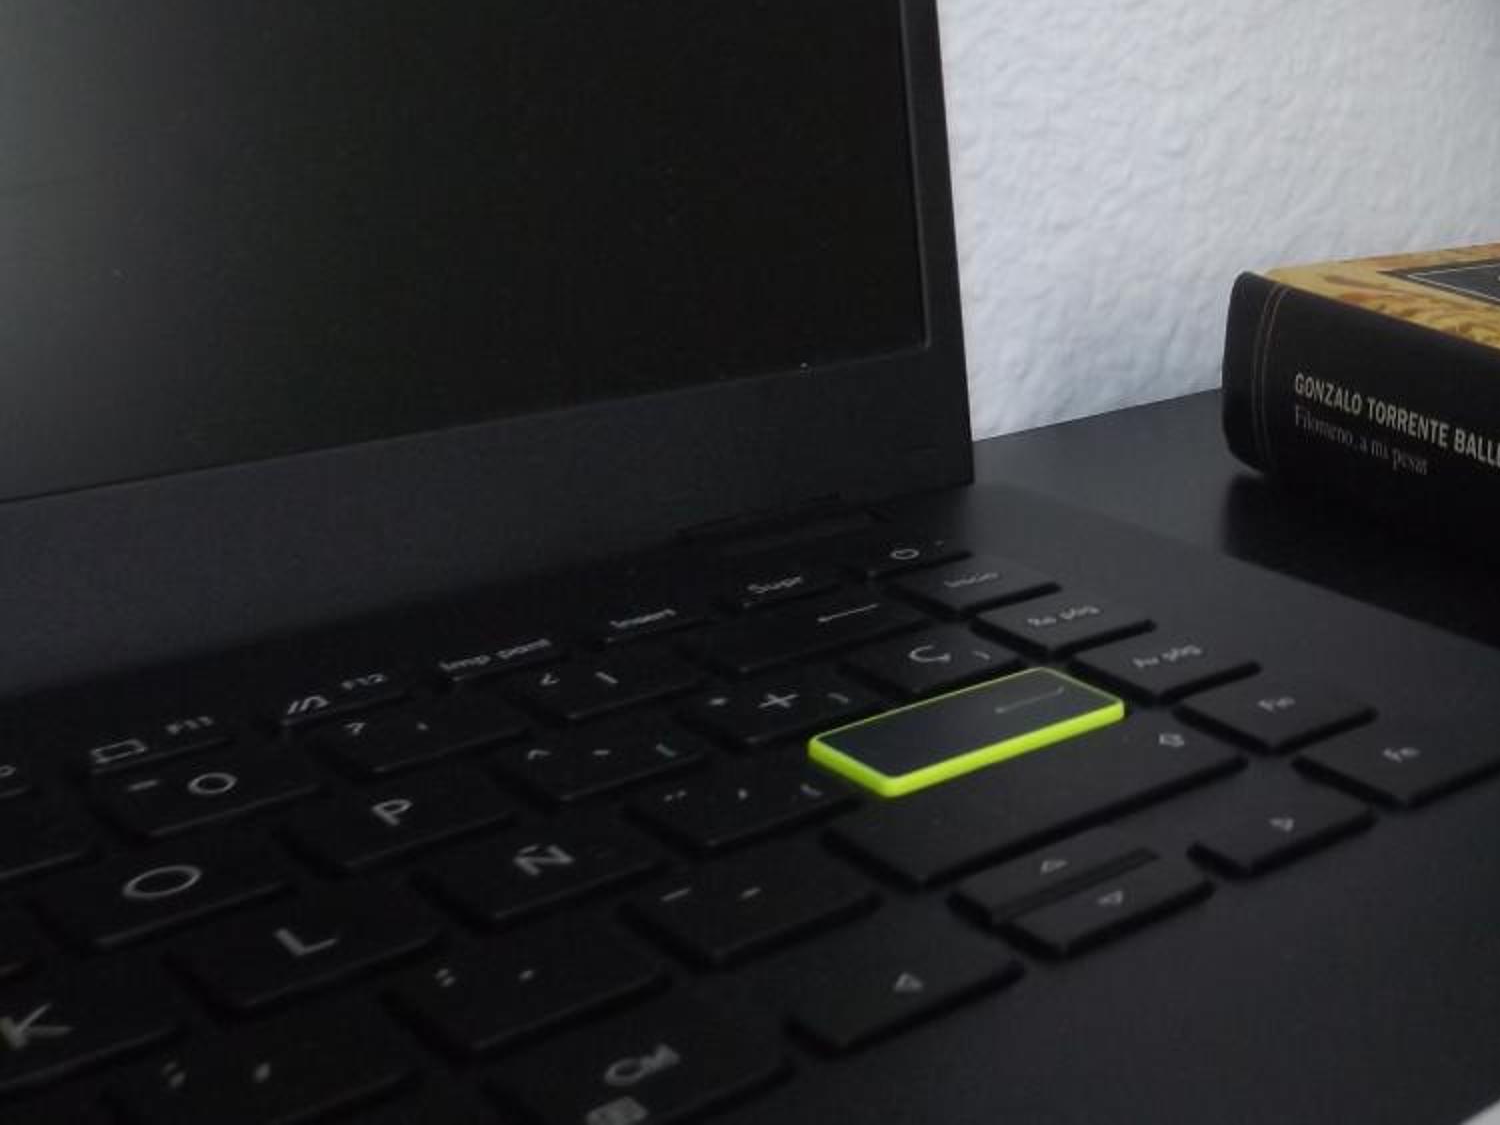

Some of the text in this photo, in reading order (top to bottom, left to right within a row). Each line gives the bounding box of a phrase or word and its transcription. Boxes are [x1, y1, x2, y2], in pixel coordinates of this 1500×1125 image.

[1294, 372, 1363, 416] GONZALO
[1365, 394, 1450, 449] TORRENTE
[371, 797, 413, 827] P
[273, 926, 341, 958] L
[0, 1002, 75, 1050] K
